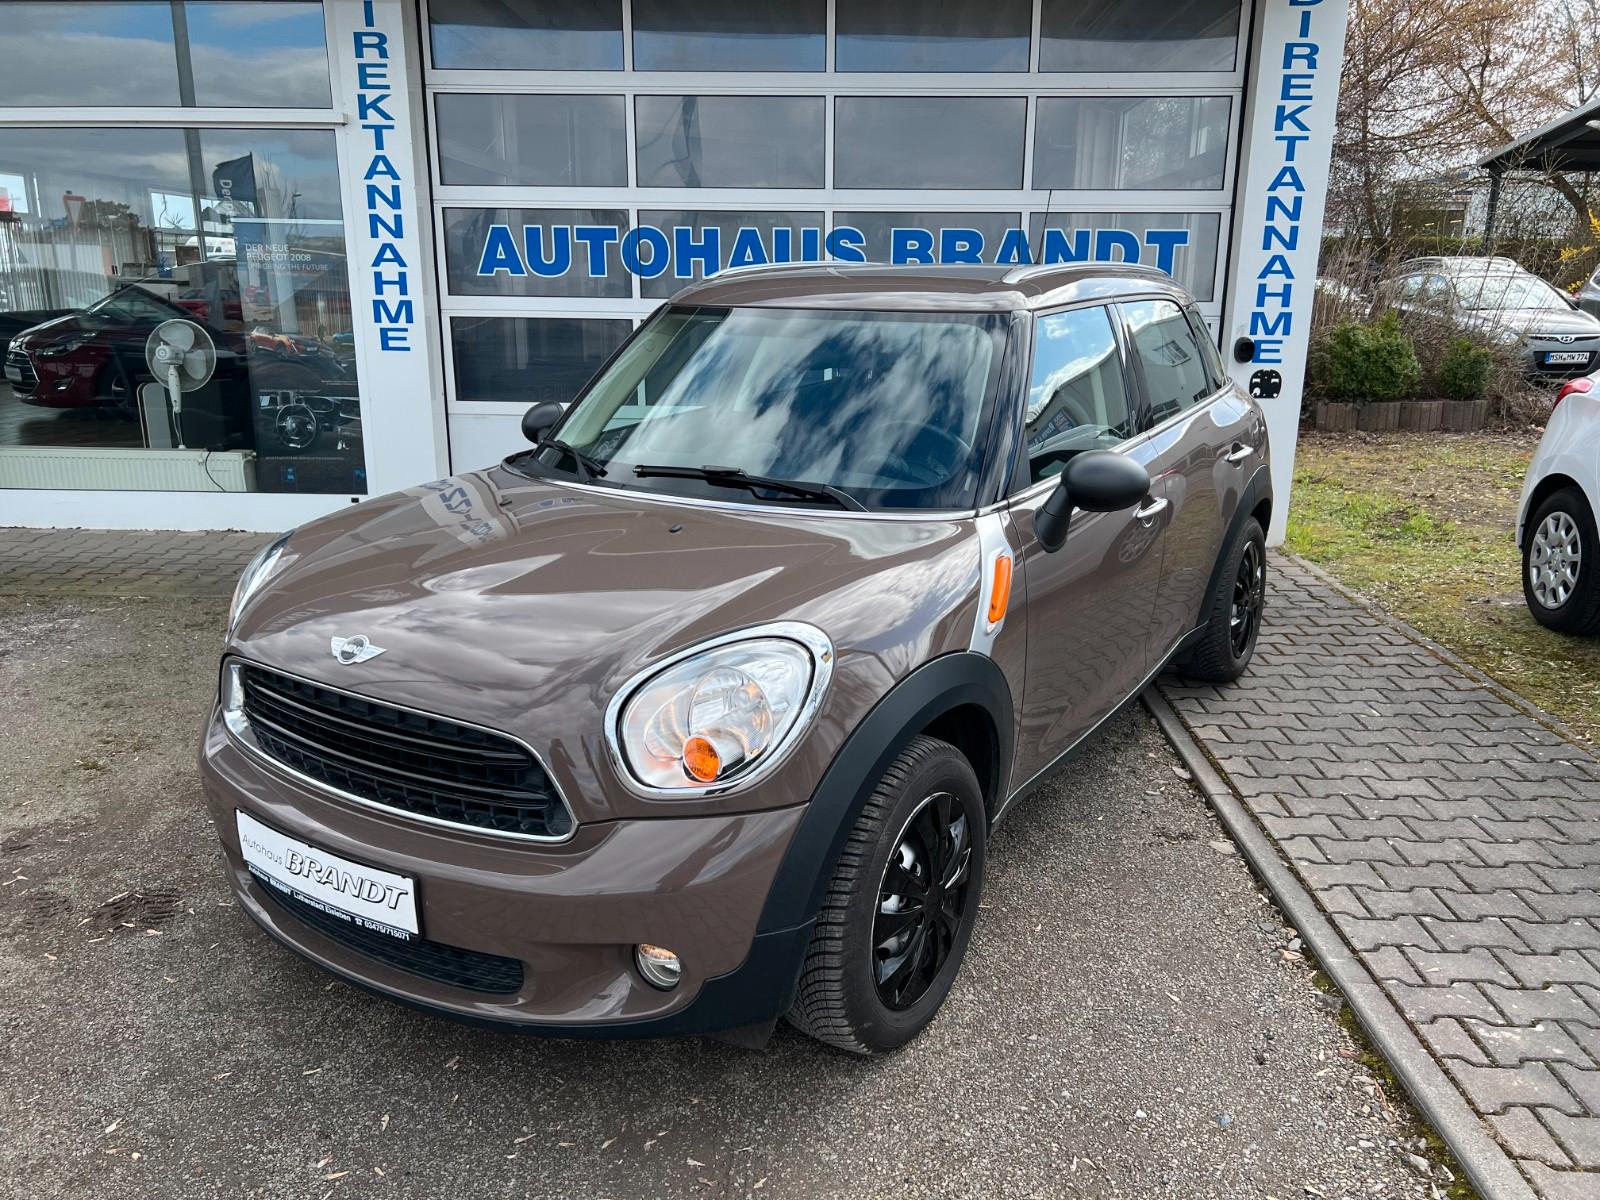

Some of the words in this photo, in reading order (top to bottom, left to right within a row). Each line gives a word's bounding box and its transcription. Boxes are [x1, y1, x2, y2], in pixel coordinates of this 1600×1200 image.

[1249, 0, 1324, 364] IREKTANNAHME
[245, 243, 263, 252] DER
[266, 243, 289, 252] NEUE
[246, 253, 288, 262] PEUGEOT
[290, 253, 312, 262] 2008
[477, 223, 867, 279] AUTOHAUS
[890, 226, 1190, 278] BRANDT
[242, 834, 283, 865] Autohaus
[284, 848, 408, 910] BRANDT
